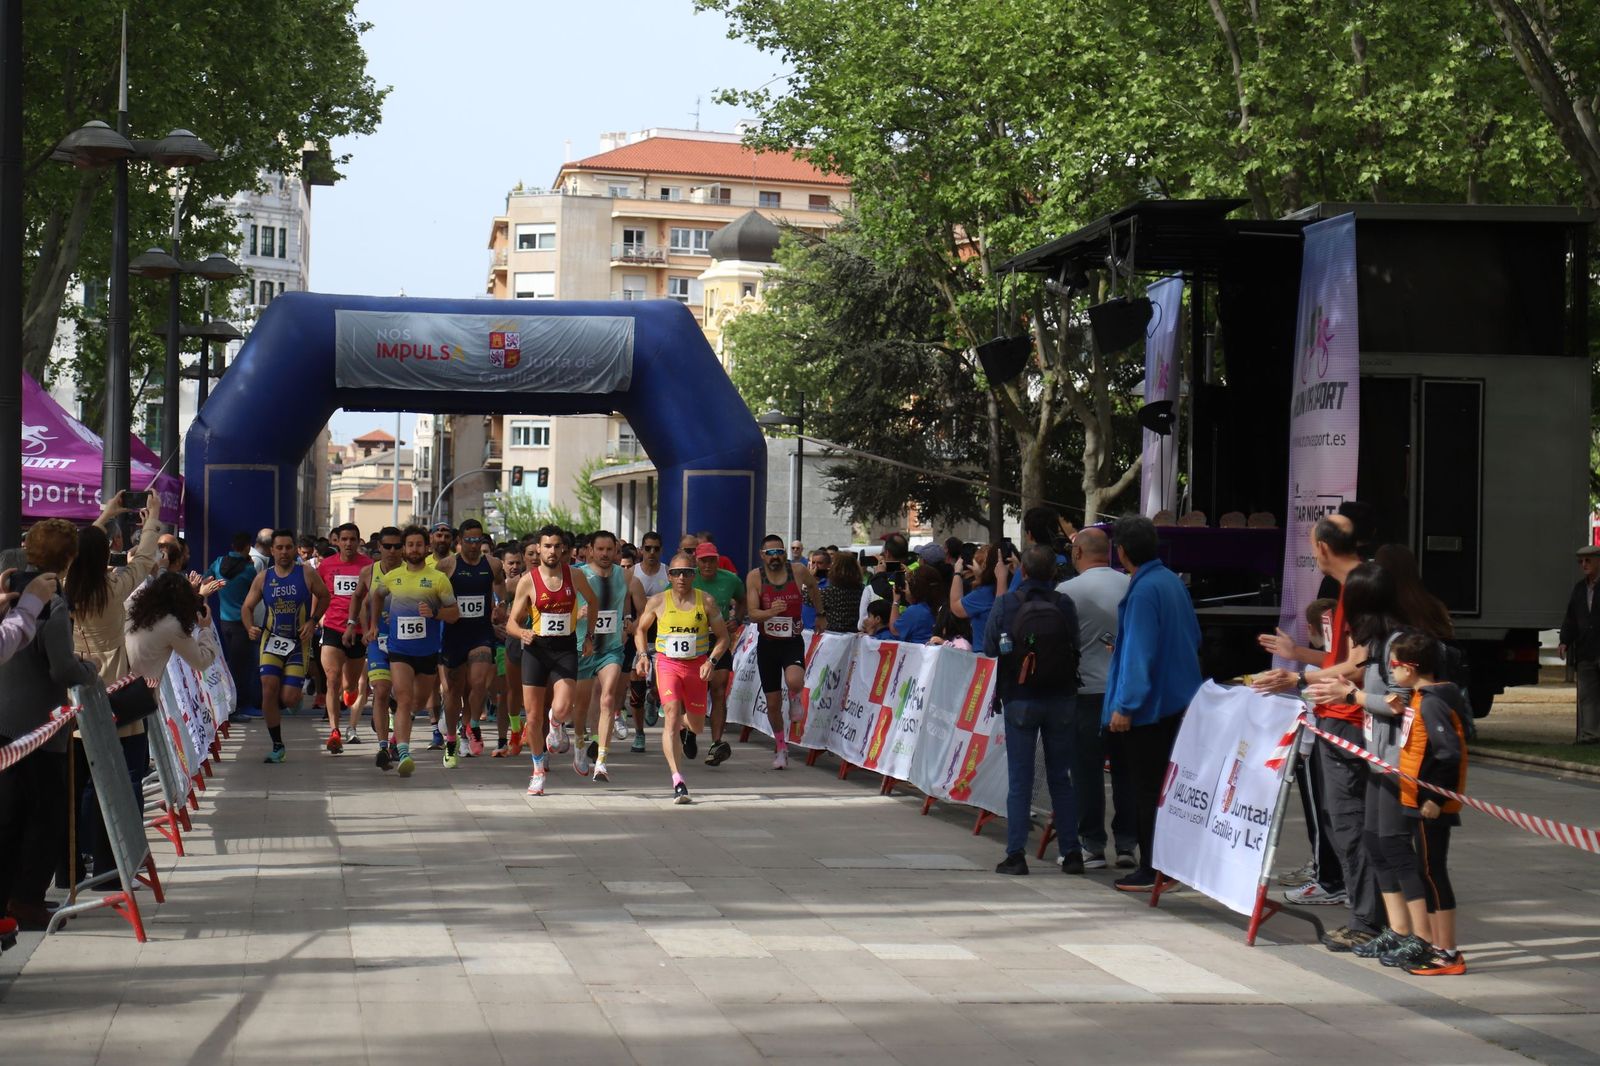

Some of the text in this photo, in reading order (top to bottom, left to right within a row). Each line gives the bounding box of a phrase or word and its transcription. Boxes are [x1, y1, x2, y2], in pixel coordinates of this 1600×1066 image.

[376, 328, 411, 340] NOS
[376, 342, 465, 365] IMPULSA
[525, 355, 595, 369] Junta de
[272, 585, 297, 598] JESUS
[337, 581, 358, 591] 159
[460, 602, 482, 612] 105
[400, 623, 424, 634] 156
[548, 620, 565, 631] 25
[767, 623, 789, 631] 266
[273, 640, 289, 652] 92
[673, 641, 690, 652] 18
[1174, 782, 1209, 810] VALORES
[1232, 829, 1241, 849] y
